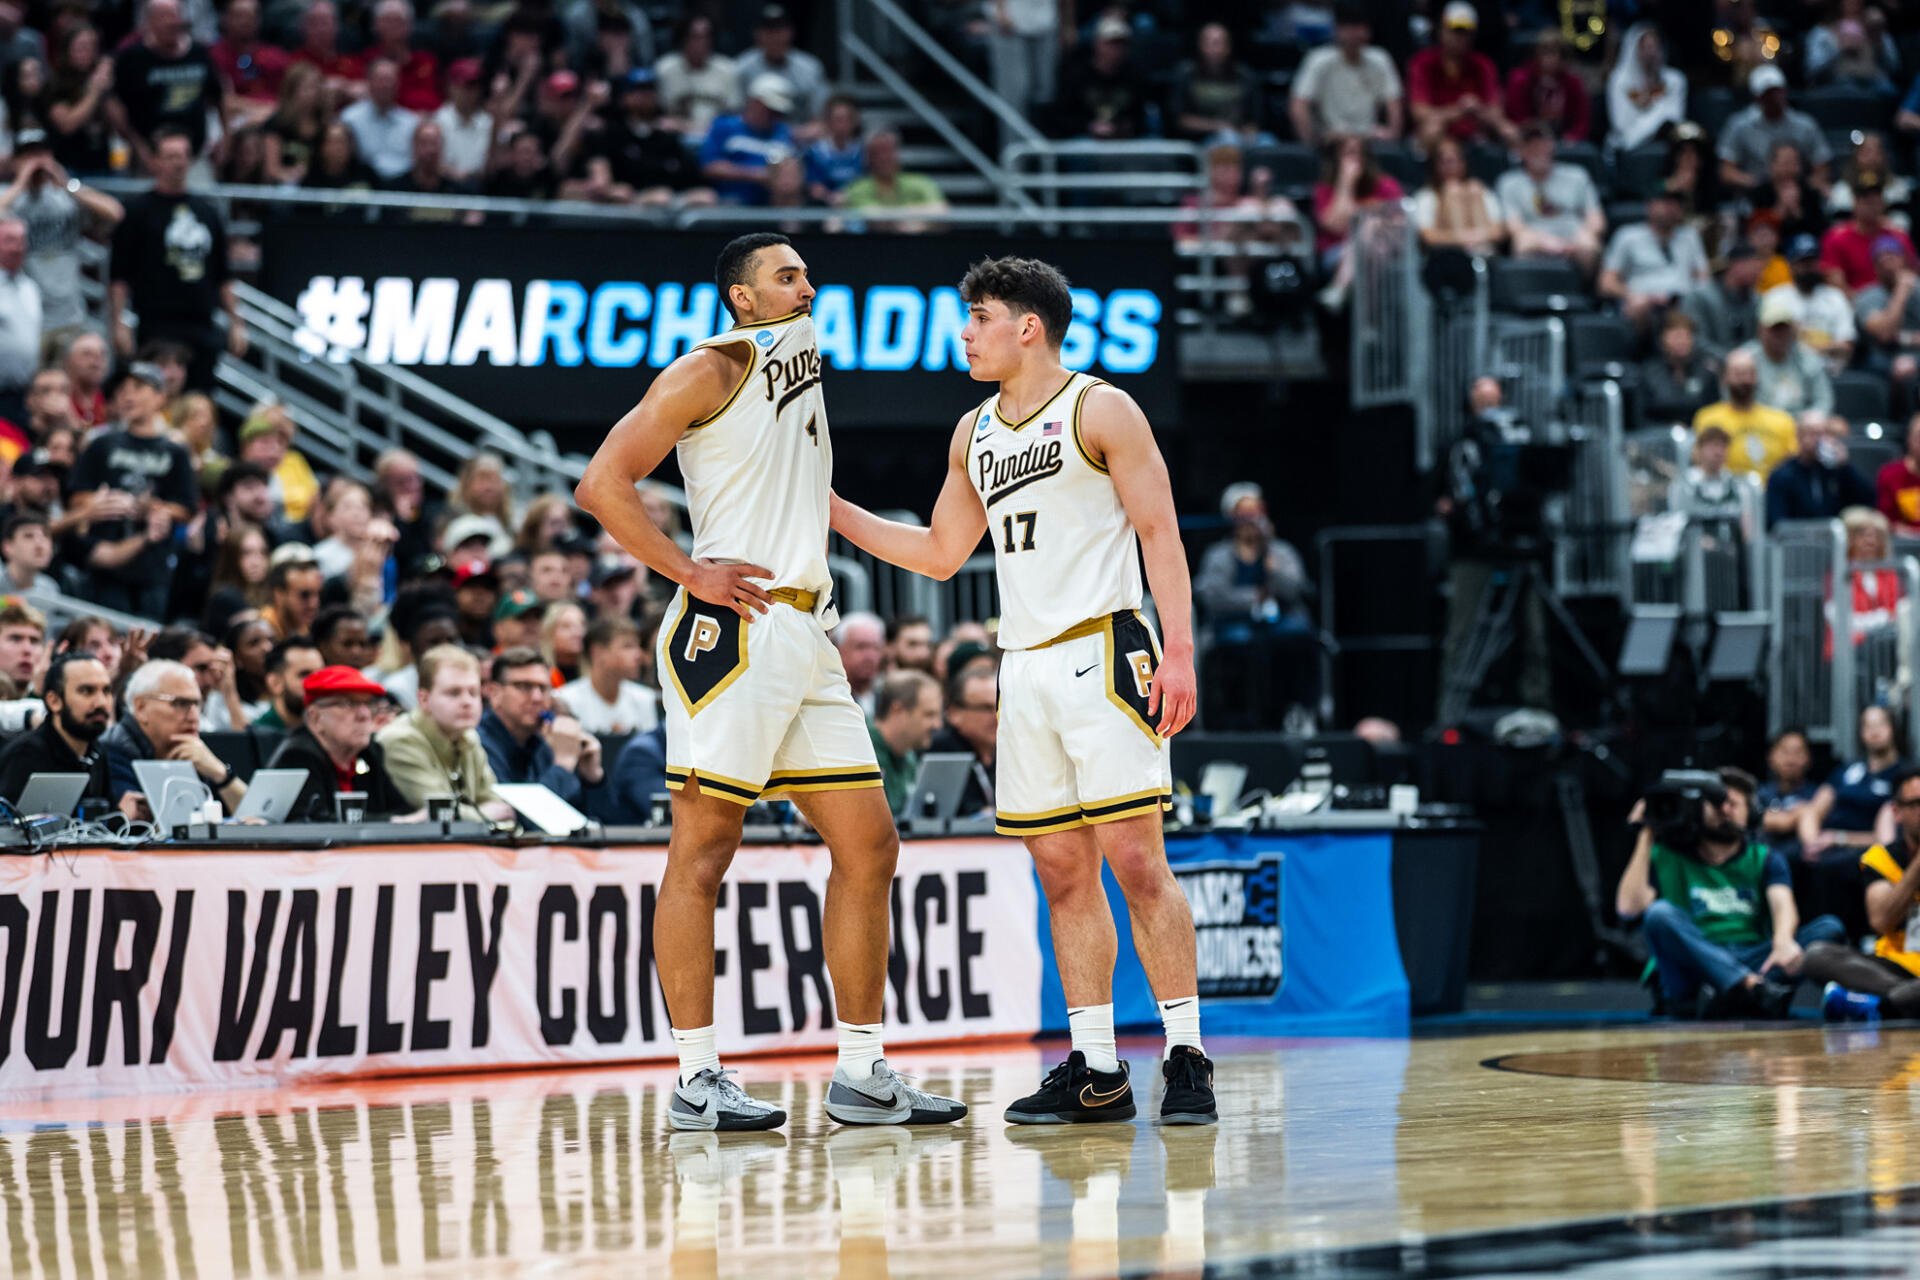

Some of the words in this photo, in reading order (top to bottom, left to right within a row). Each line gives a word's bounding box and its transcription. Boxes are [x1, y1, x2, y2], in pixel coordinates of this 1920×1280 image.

[805, 411, 818, 447] 4
[977, 440, 1064, 493] Purdue
[1003, 511, 1038, 554] 17
[684, 613, 721, 662] P
[213, 882, 510, 1063] VALLEY
